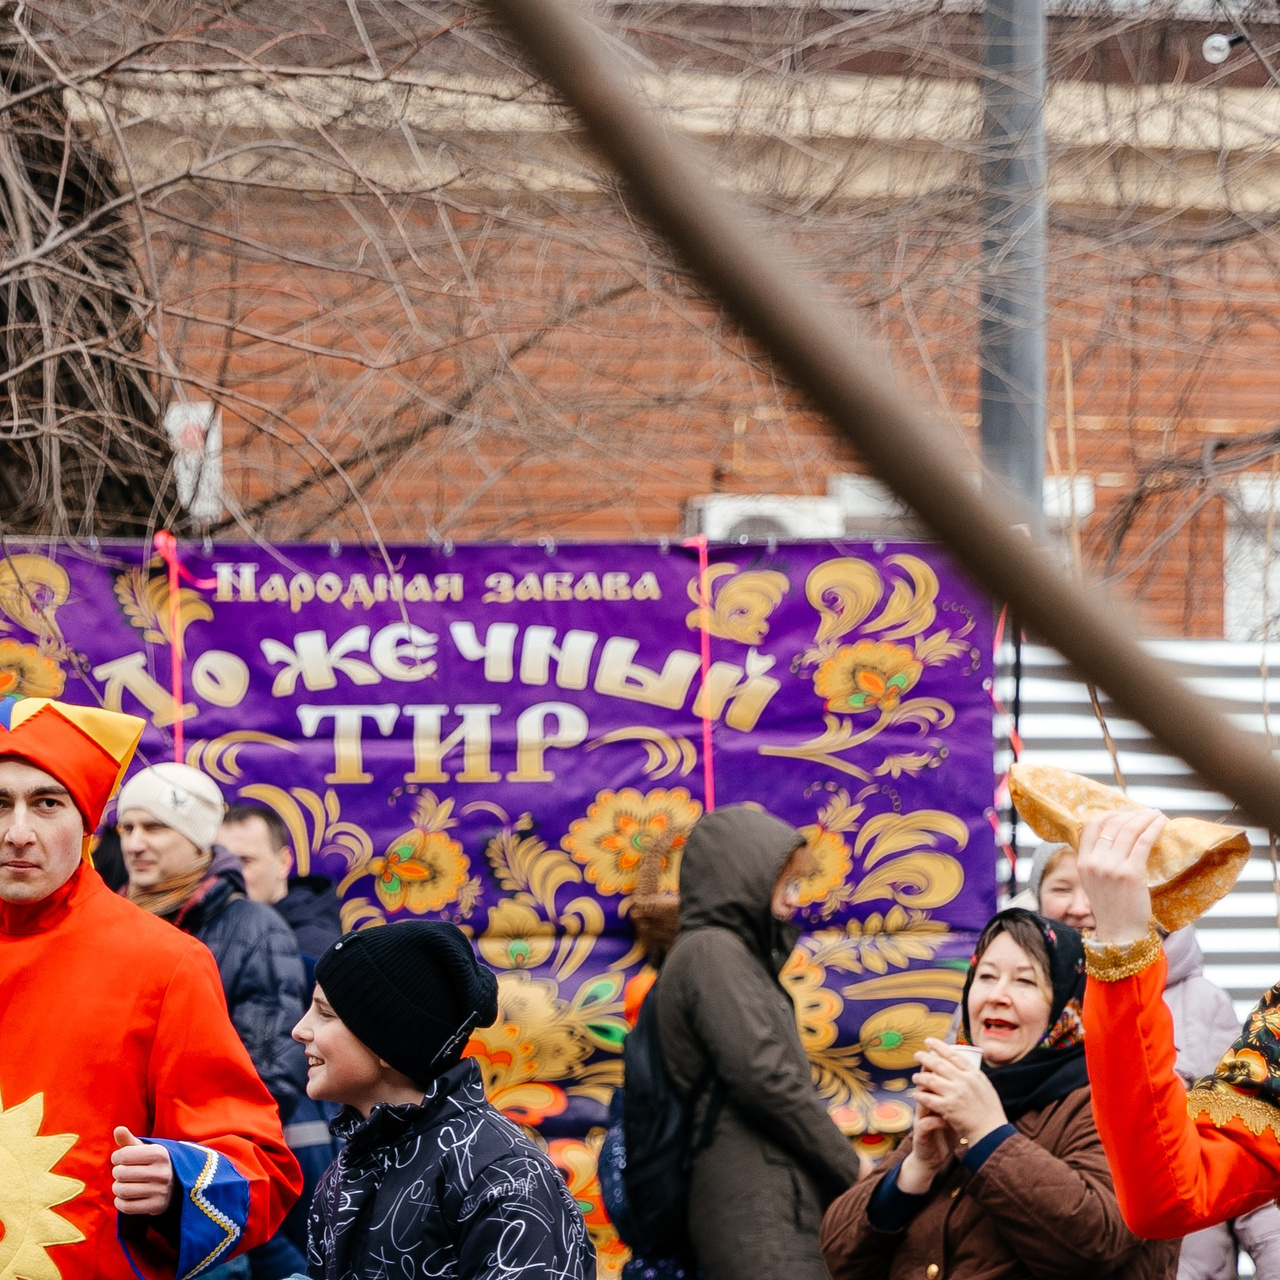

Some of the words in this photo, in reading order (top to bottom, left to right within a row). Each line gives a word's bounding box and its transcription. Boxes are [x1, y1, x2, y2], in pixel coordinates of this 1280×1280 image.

[211, 562, 464, 614] Народная
[481, 571, 663, 604] забава
[296, 701, 590, 785] ТИР
